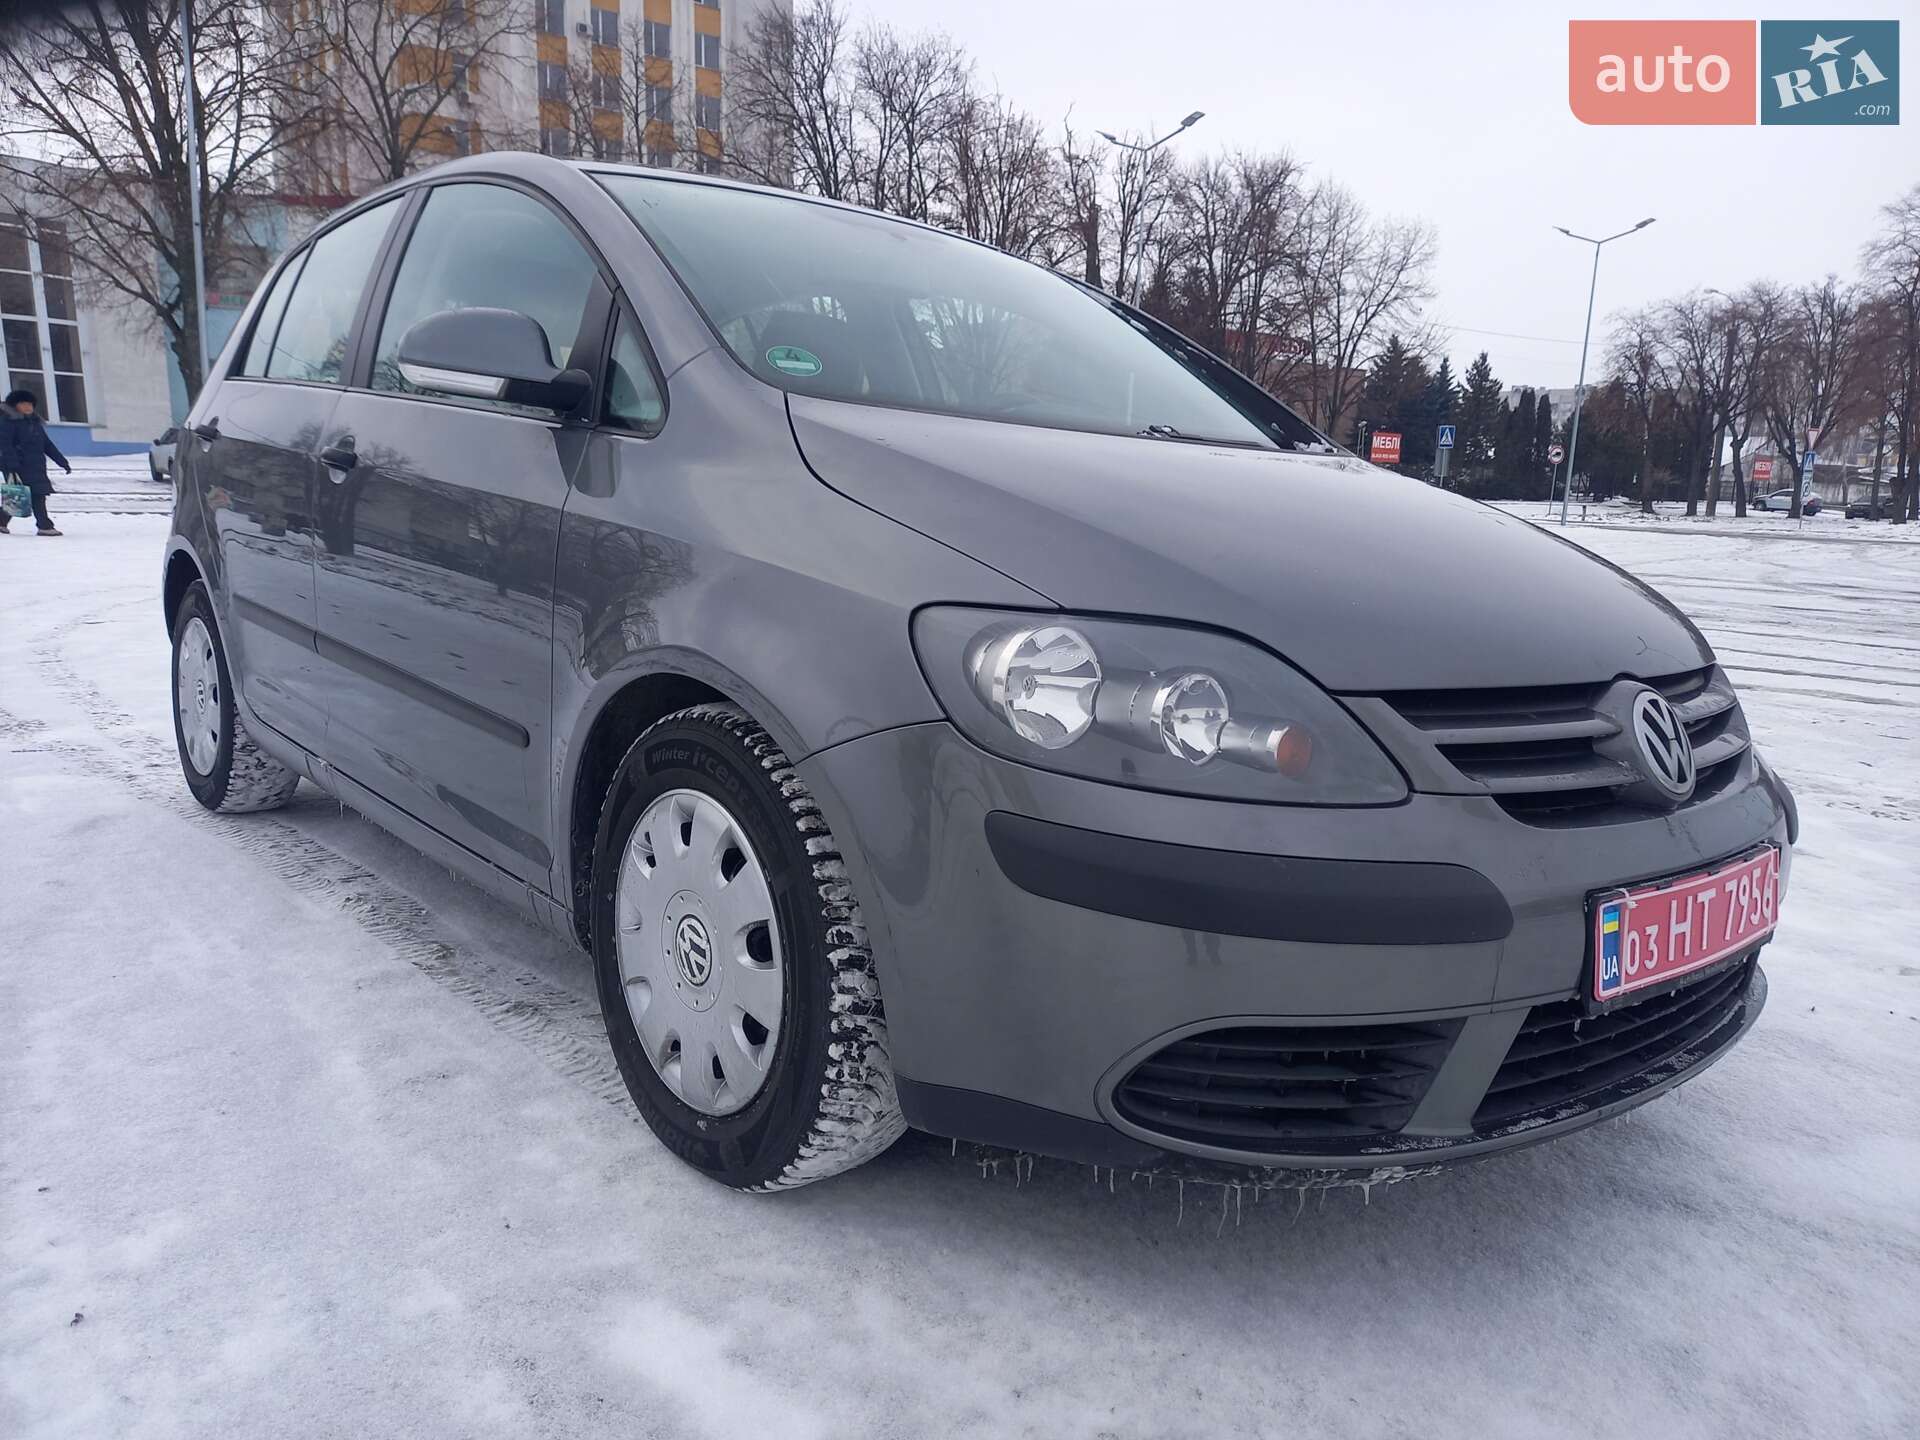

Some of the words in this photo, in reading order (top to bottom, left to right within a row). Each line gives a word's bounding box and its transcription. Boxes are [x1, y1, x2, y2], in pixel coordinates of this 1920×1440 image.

[1372, 435, 1400, 449] МЕБЛІ
[651, 747, 690, 765] Winter
[1625, 924, 1660, 976] 03
[1668, 888, 1717, 962] HT
[1724, 862, 1773, 941] 7956
[1602, 955, 1619, 980] UA
